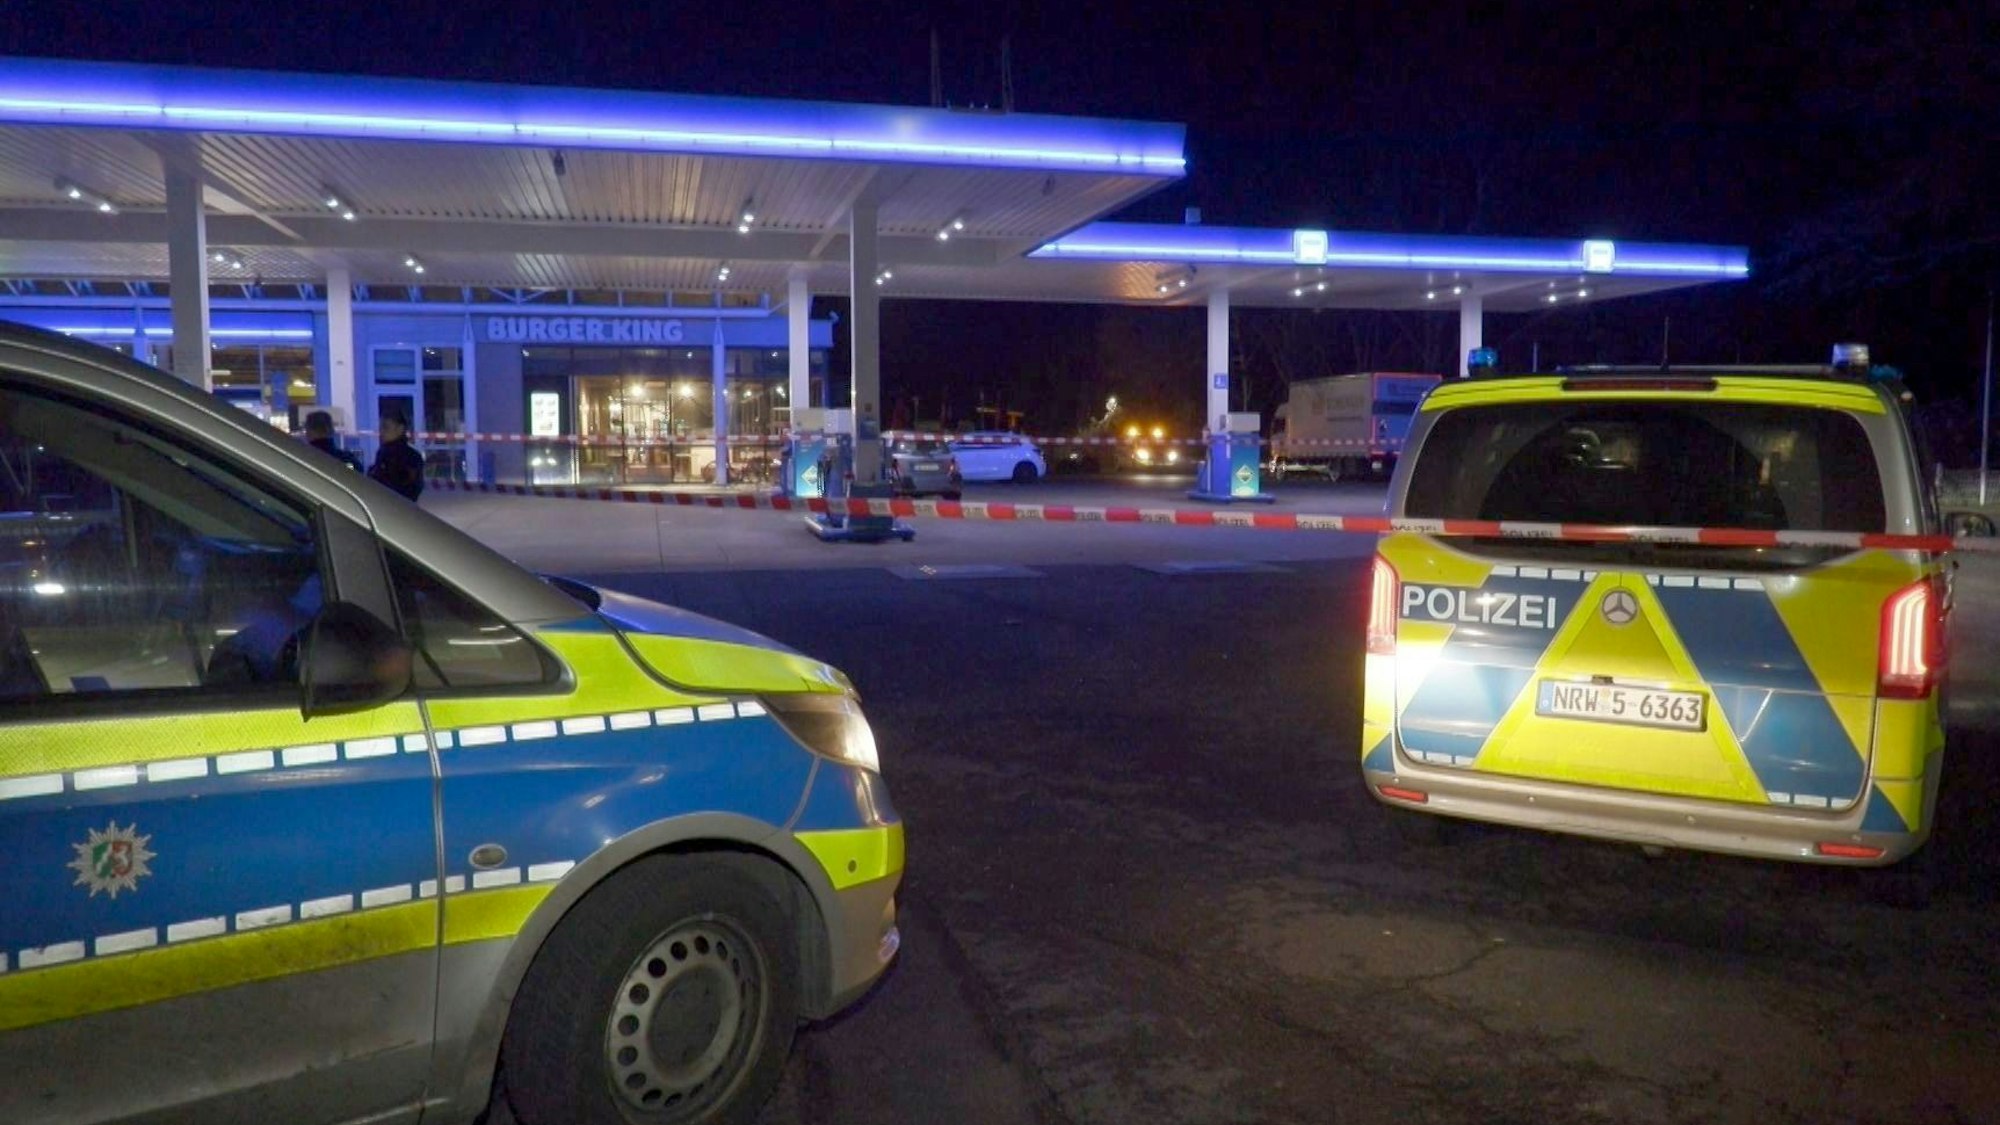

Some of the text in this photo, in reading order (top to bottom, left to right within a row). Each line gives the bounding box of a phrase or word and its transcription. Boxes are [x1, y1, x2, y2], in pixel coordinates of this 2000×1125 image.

[487, 316, 684, 342] BURGER KING
[1402, 585, 1557, 629] POLIZEI
[1553, 685, 1599, 712] NRW
[1639, 694, 1700, 723] 6363
